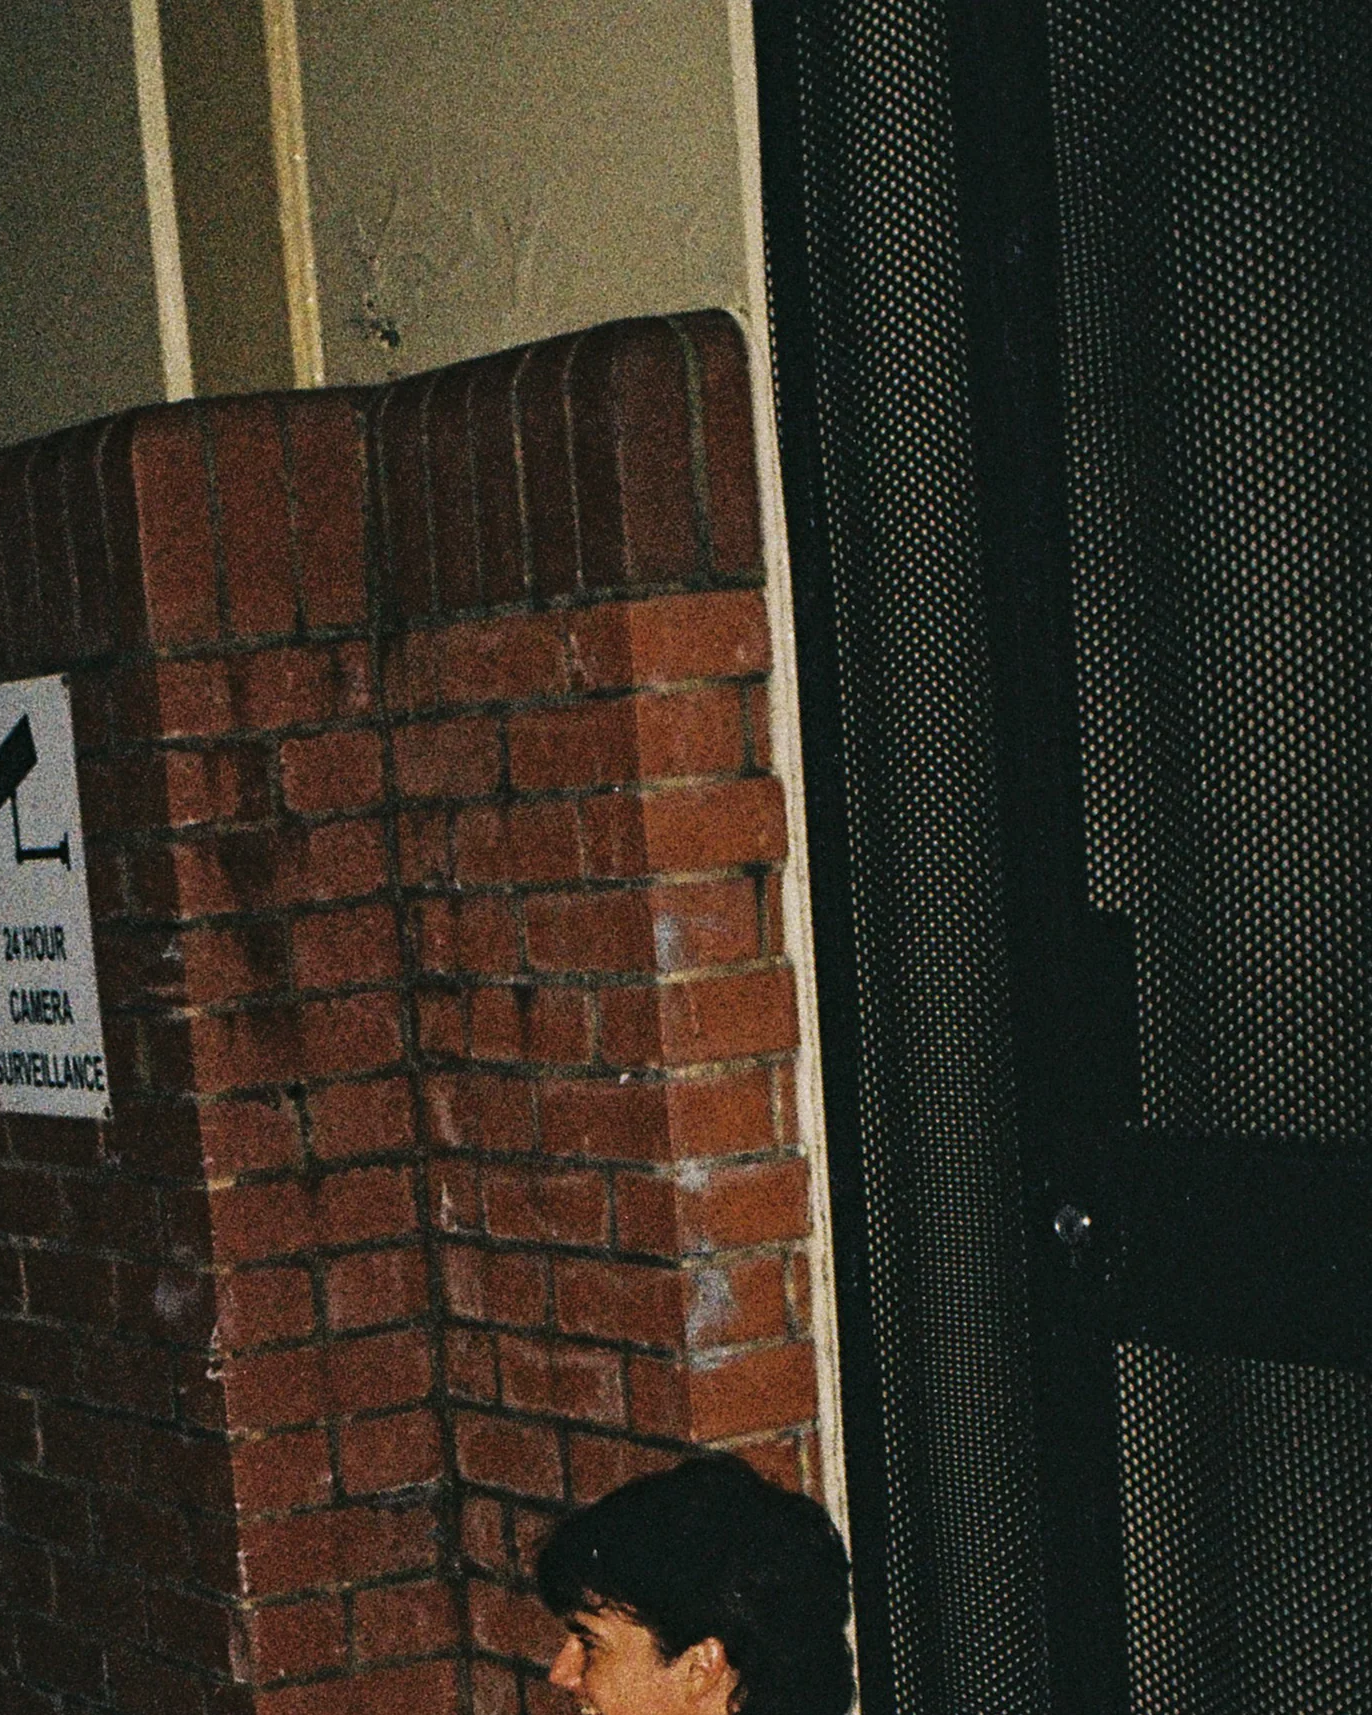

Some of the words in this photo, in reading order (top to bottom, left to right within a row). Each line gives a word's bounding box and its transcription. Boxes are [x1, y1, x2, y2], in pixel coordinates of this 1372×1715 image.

[3, 925, 21, 961] 24
[22, 926, 67, 961] HOUR
[9, 989, 74, 1025] CAMERA
